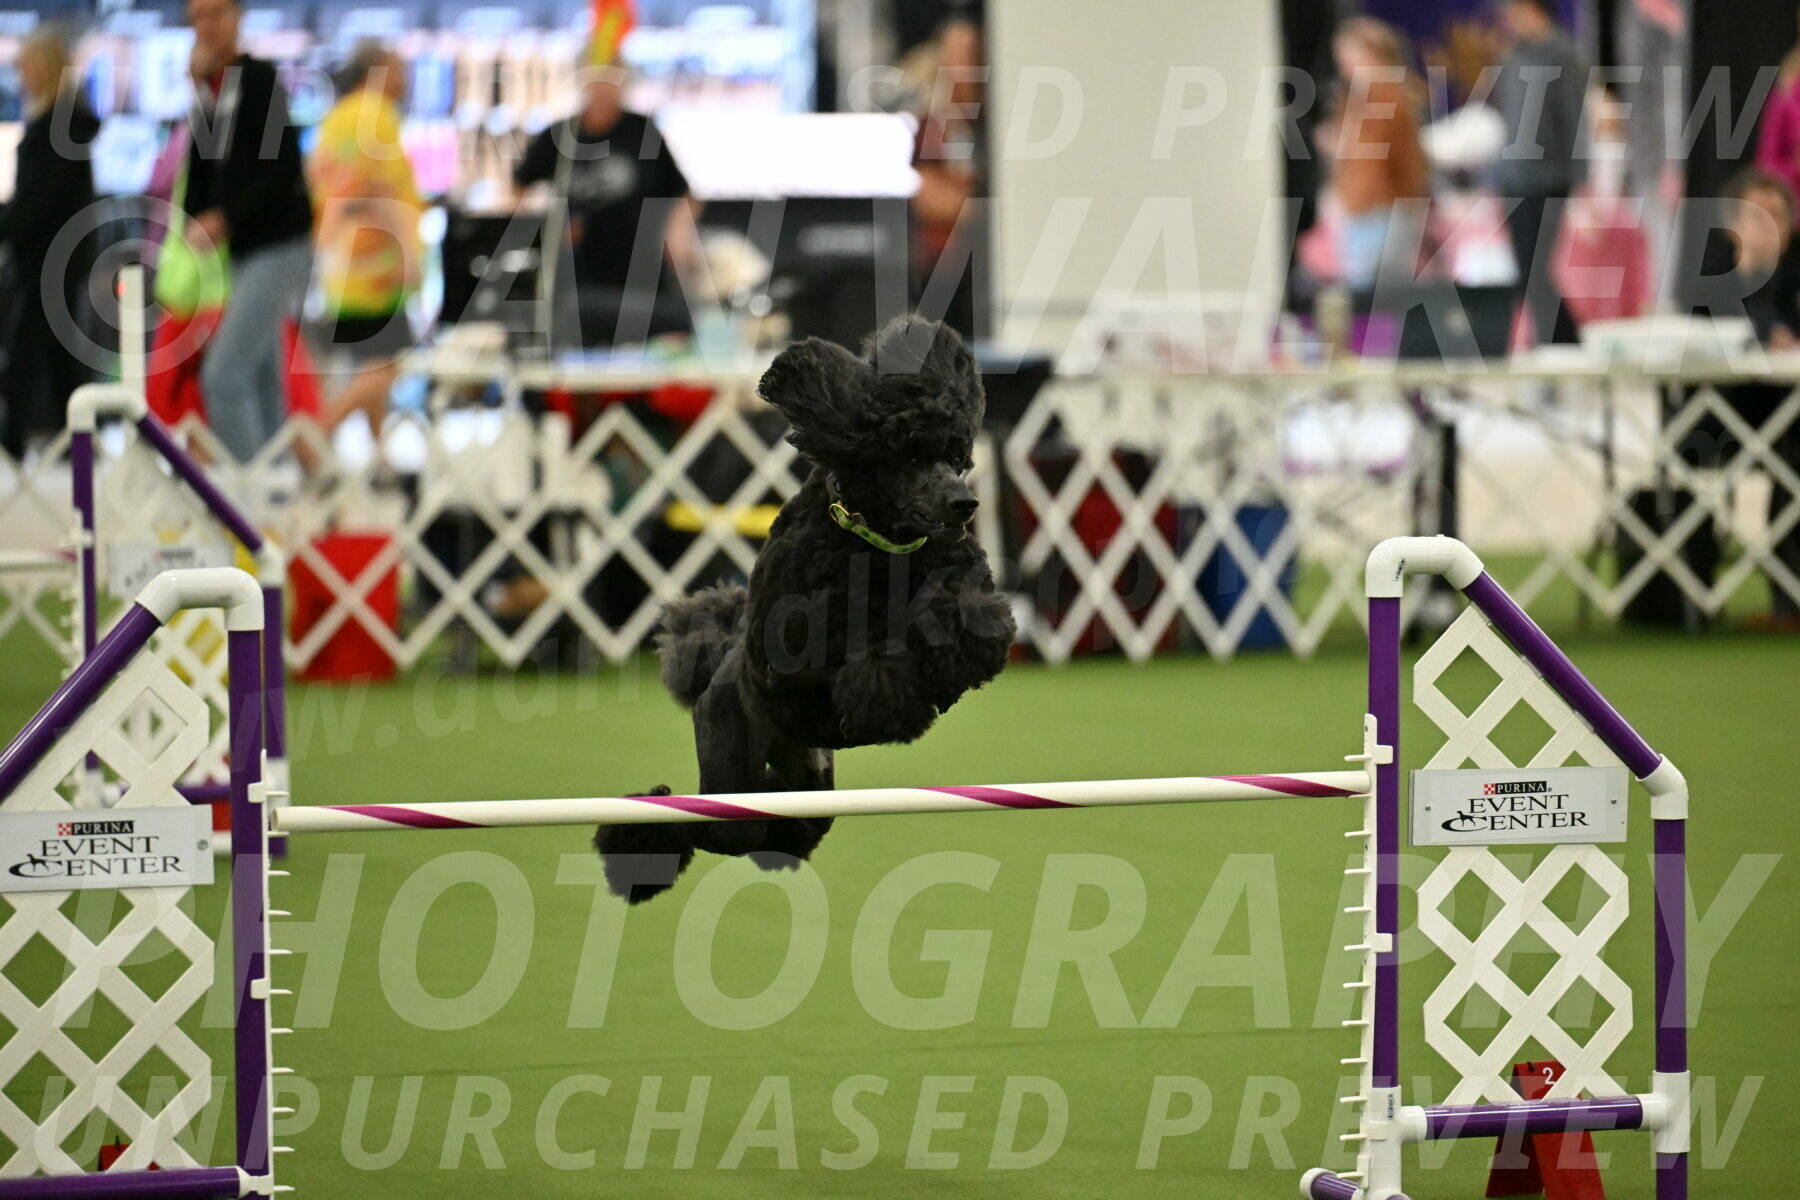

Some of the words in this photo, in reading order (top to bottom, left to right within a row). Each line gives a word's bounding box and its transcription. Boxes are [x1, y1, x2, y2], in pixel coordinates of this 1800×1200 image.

[1496, 781, 1546, 794] PURINA
[1467, 794, 1570, 814] EVENT
[73, 821, 133, 835] PURINA
[1441, 811, 1590, 832] CENTER
[40, 836, 160, 857] EVENT
[8, 855, 185, 878] CENTER
[1542, 1066, 1556, 1085] 2
